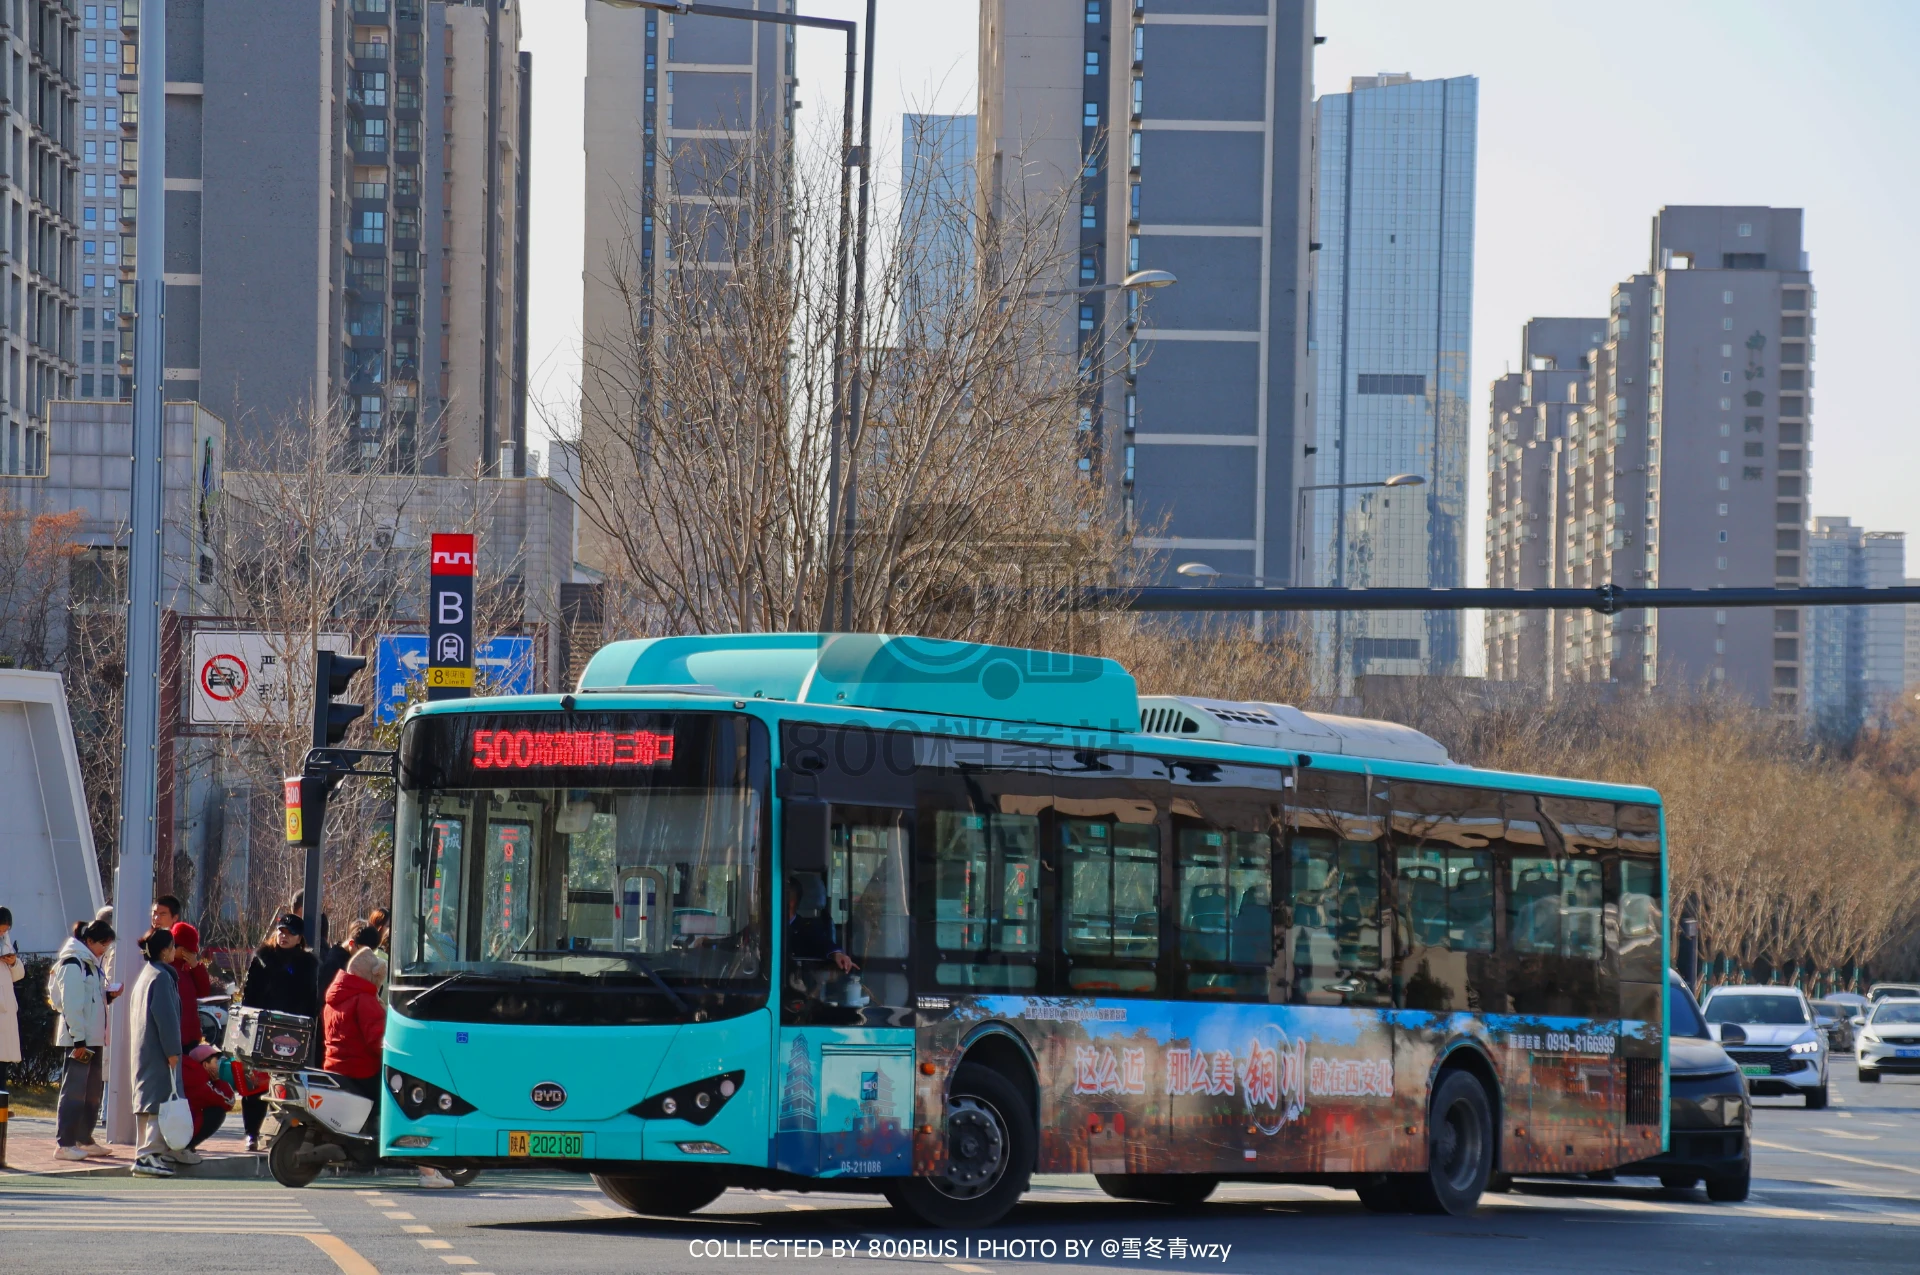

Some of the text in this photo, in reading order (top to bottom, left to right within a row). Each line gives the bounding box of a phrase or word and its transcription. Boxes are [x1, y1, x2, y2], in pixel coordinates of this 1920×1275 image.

[439, 591, 463, 625] B
[434, 669, 444, 684] 8
[392, 682, 405, 697] 曲
[286, 786, 299, 804] 500
[1546, 1032, 1615, 1054] 0919-8166999
[1074, 1037, 1394, 1112] 这么近 那么美 铜川 就在西安北
[534, 1090, 562, 1102] BYD
[510, 1135, 581, 1154] 陕A 20218D
[841, 1160, 882, 1173] 05-211086
